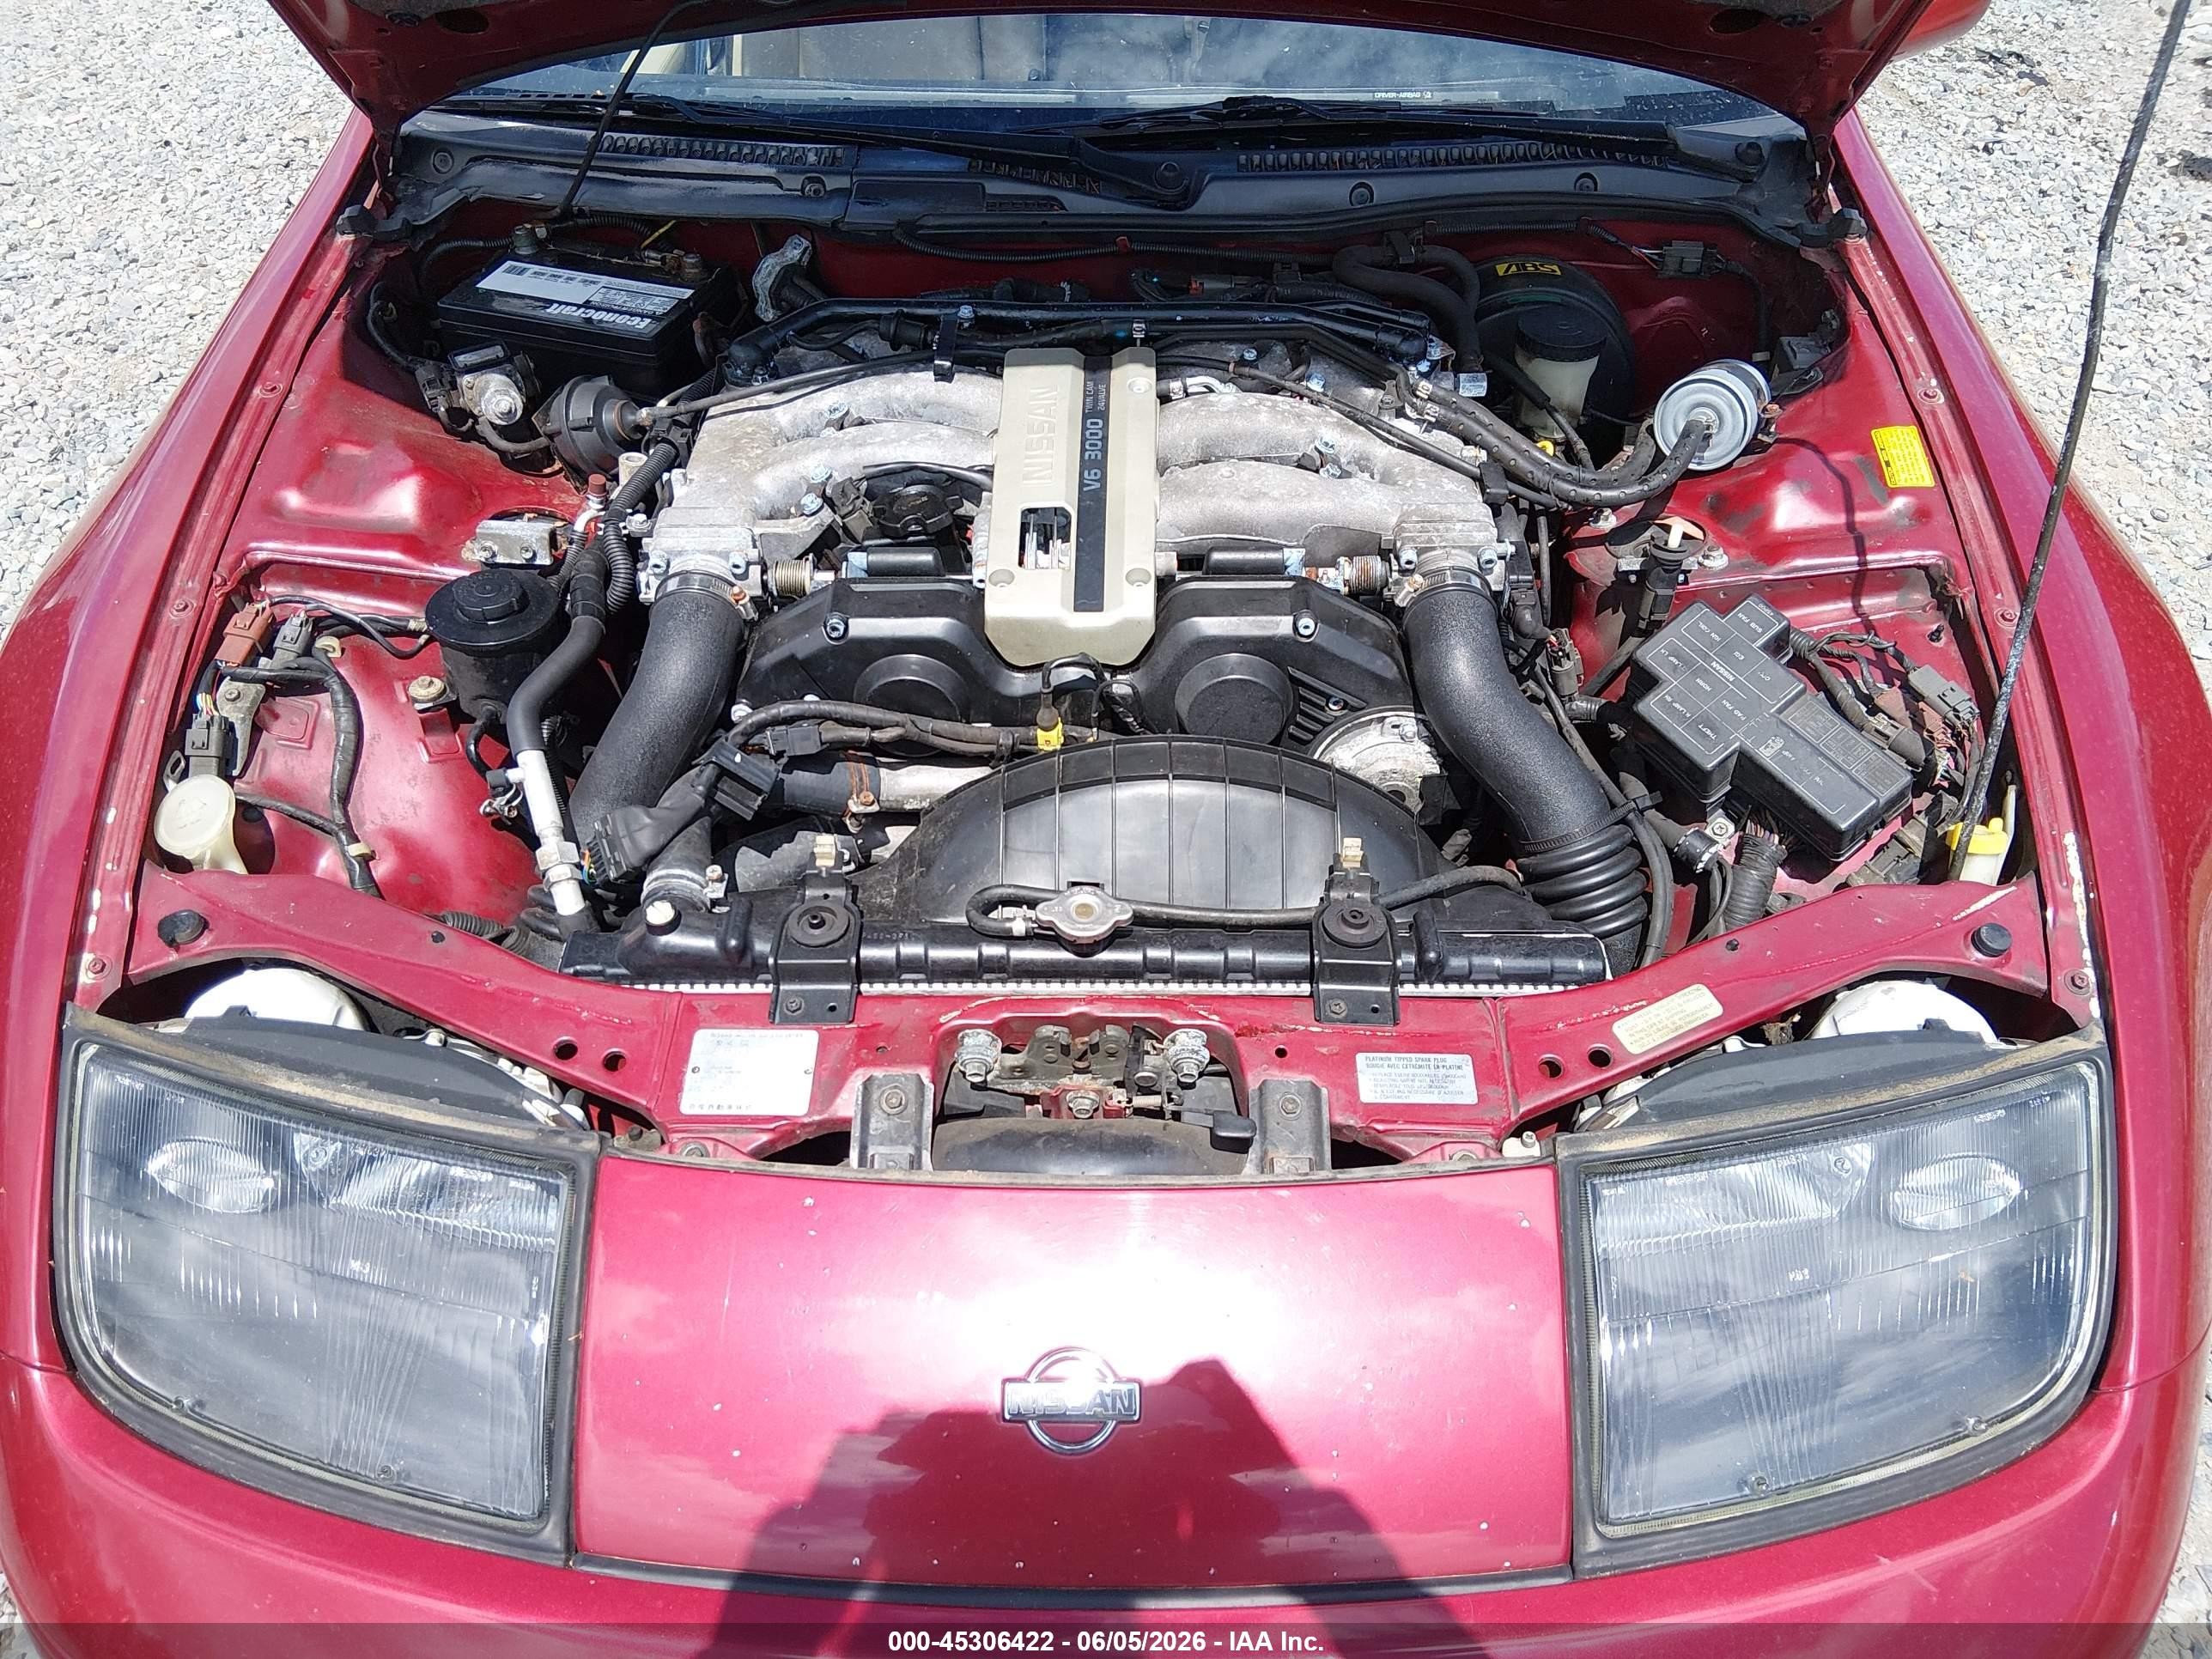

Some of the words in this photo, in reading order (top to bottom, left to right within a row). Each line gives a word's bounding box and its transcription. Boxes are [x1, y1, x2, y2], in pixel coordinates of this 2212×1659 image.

[1503, 262, 1558, 275] ABS
[545, 303, 652, 330] Econocraft
[1086, 380, 1095, 394] CAM
[1085, 394, 1094, 413] TWIN
[1097, 384, 1107, 411] 24VALVE
[1023, 385, 1059, 487] NISSAN
[1085, 418, 1103, 460] 3000
[1083, 468, 1102, 492] V6
[1737, 612, 1751, 623] FAN
[1749, 622, 1763, 634] SUB
[1710, 632, 1722, 642] IGN
[1711, 660, 1736, 682] NISSAN
[1695, 678, 1712, 692] HORN
[1722, 699, 1734, 710] FAN
[1698, 724, 1717, 740] THEFT
